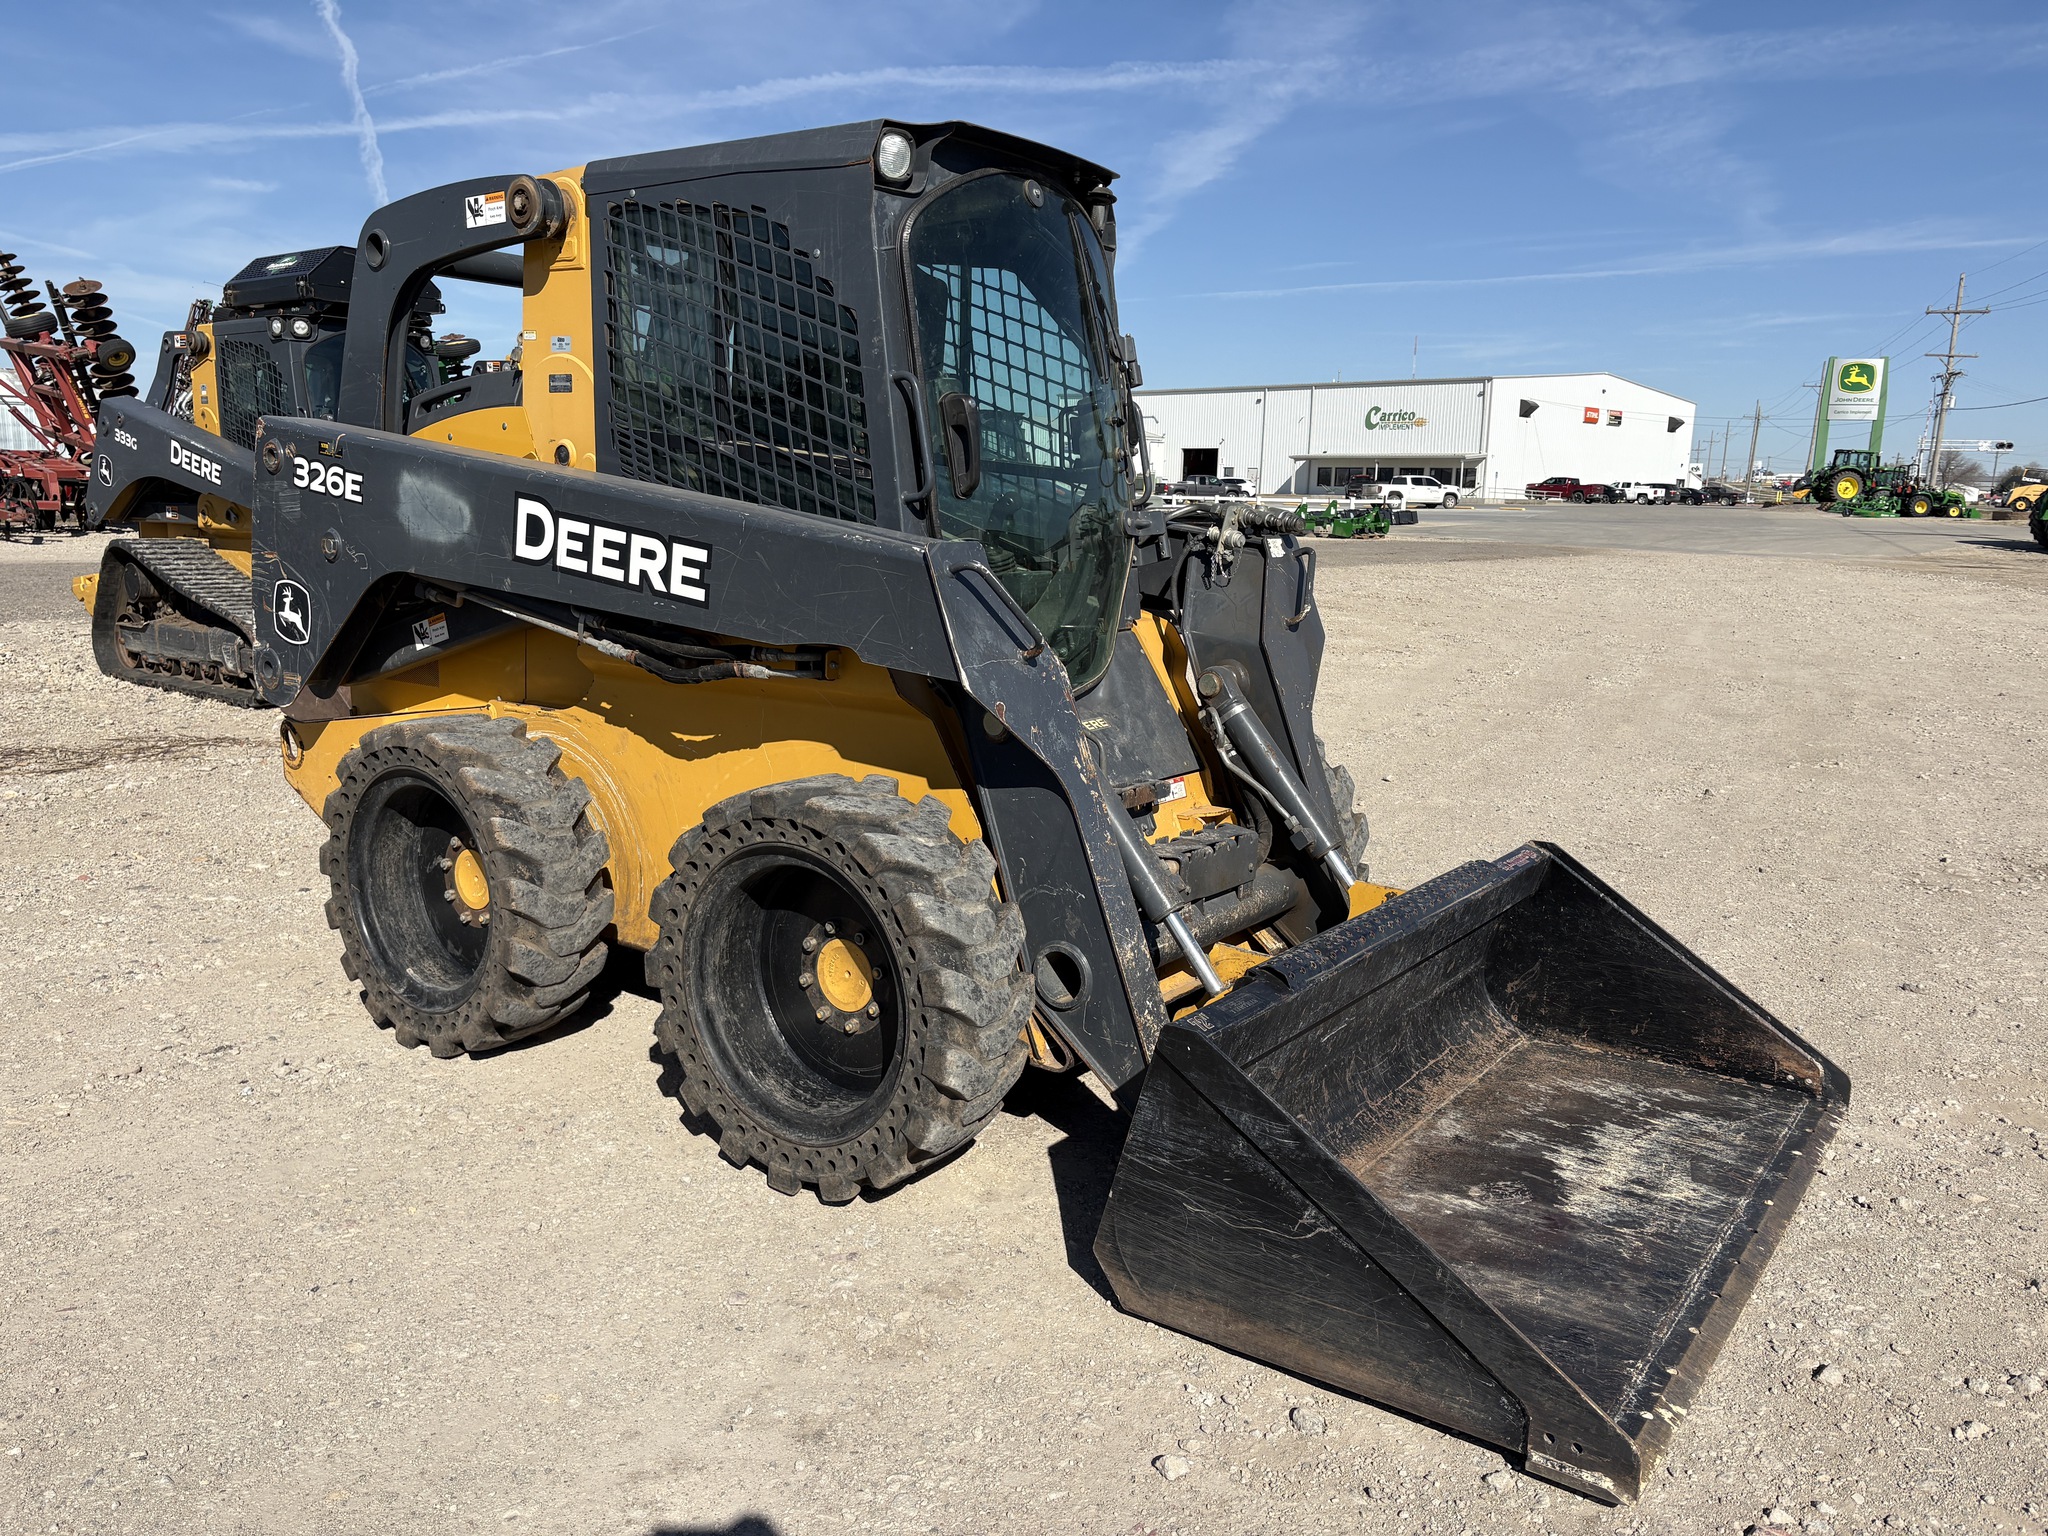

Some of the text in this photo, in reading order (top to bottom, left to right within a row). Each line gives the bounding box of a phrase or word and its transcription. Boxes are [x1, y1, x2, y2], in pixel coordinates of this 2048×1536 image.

[1365, 405, 1416, 430] Carrico
[1586, 411, 1599, 419] STIHL
[114, 427, 138, 450] 333G
[170, 439, 222, 486] DEERE
[293, 456, 363, 503] 326E
[515, 497, 709, 602] DEERE
[1082, 718, 1109, 731] ERE
